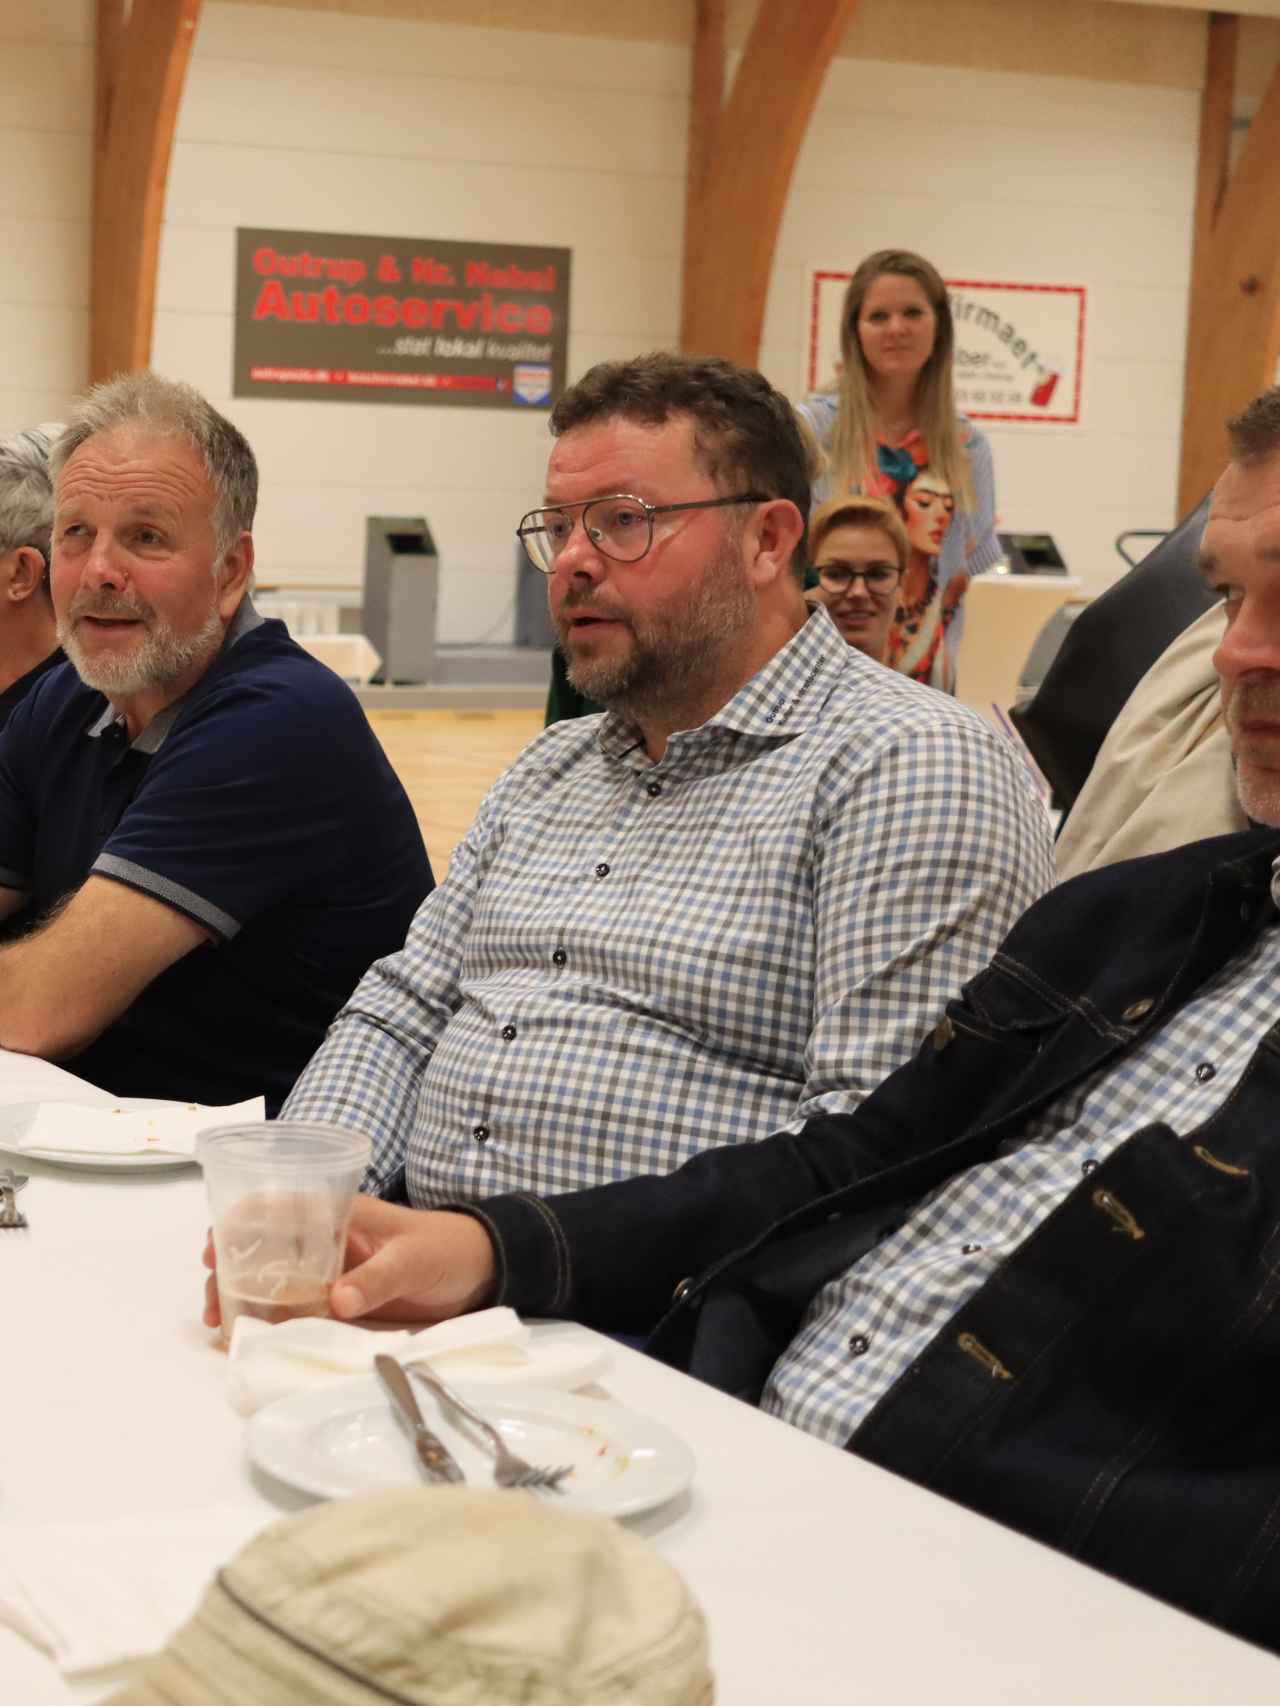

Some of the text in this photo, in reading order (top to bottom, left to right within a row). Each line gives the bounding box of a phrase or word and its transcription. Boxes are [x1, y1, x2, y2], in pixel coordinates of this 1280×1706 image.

[252, 247, 366, 286] Outrup
[376, 254, 402, 283] &
[251, 279, 554, 335] Autoservice
